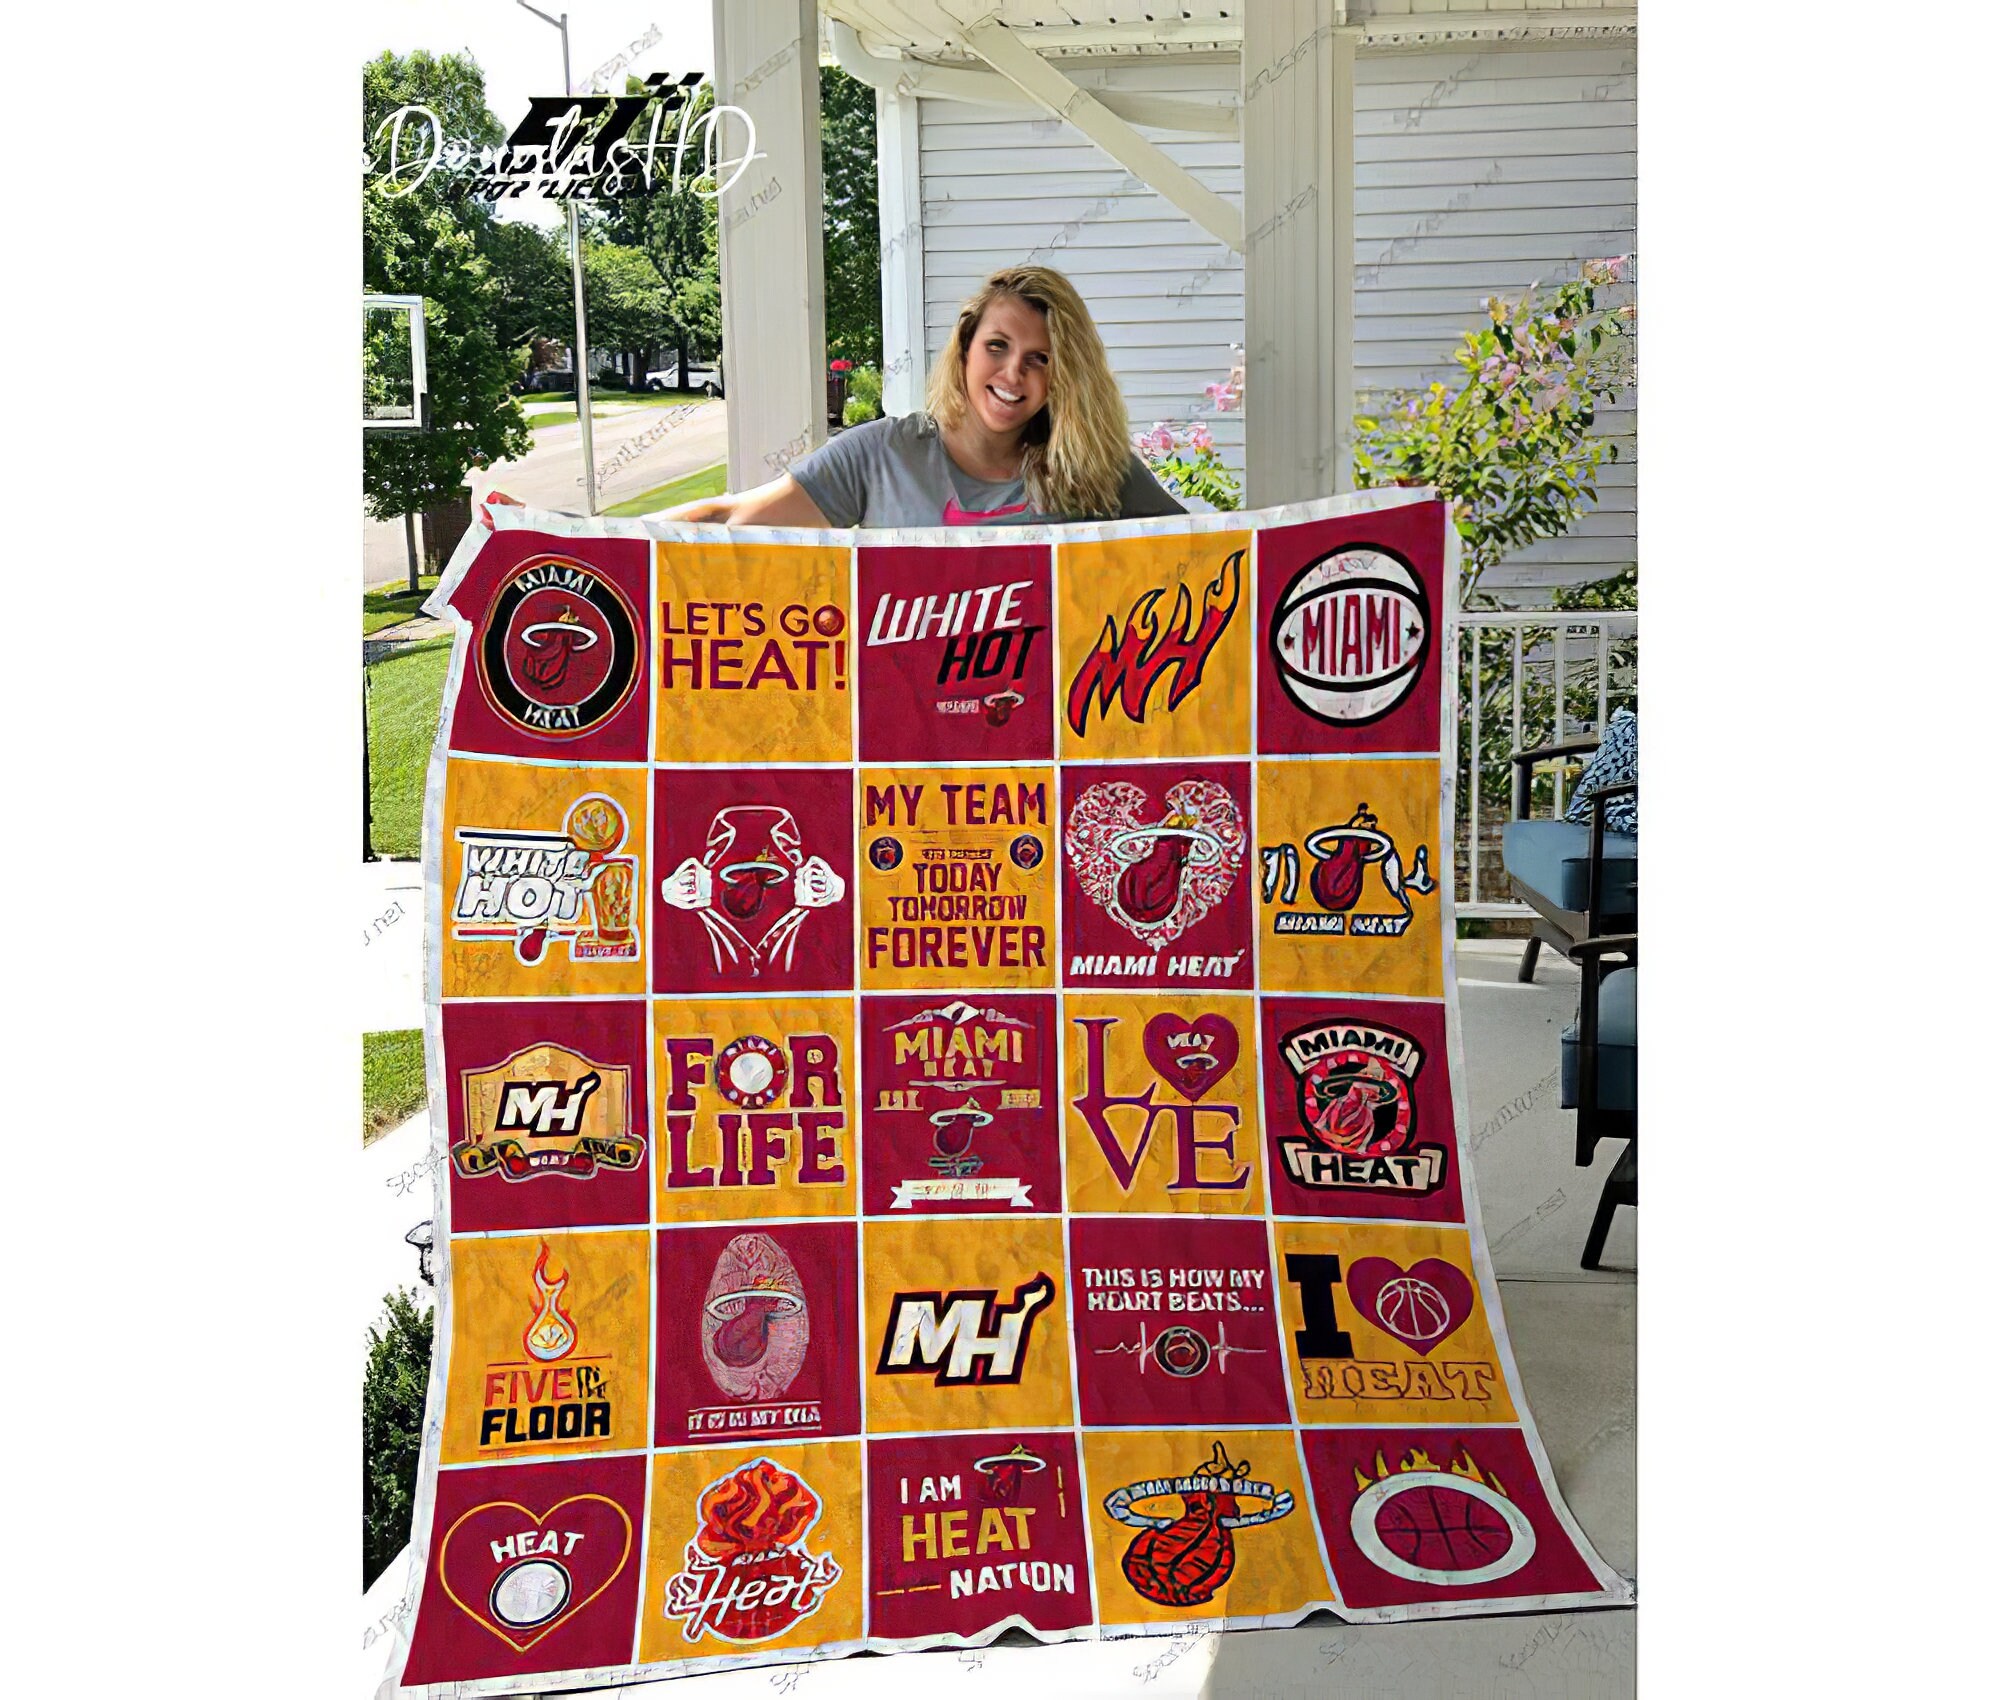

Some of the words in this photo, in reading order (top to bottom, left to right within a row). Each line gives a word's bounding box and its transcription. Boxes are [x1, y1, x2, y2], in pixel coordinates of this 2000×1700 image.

[662, 601, 767, 638] LET'S
[779, 603, 846, 638] GO
[866, 580, 1034, 647] WHITE
[1302, 593, 1401, 676] MIAMI
[661, 638, 847, 691] HEAT!
[936, 625, 1048, 685] HOT
[866, 784, 923, 827] MY
[940, 782, 1047, 826] TEAM
[457, 874, 586, 921] HOT
[912, 862, 1003, 893] TODAY
[887, 895, 1028, 922] TOMORROW
[867, 926, 1047, 969] FOREVER
[1069, 954, 1158, 976] MIAMI
[1166, 947, 1246, 978] HEAT
[894, 1026, 1024, 1065] MIAMI
[495, 1071, 601, 1137] MH
[666, 1111, 845, 1188] LIFE
[1311, 1154, 1421, 1187] HEAT
[1082, 1268, 1136, 1288] THIS
[1169, 1269, 1224, 1288] HOW
[1285, 1253, 1355, 1359] I
[876, 1271, 1056, 1387] MH
[485, 1368, 573, 1407] FIVE
[480, 1402, 611, 1446] FLOOR
[900, 1476, 909, 1504] I
[919, 1474, 962, 1503] AM
[489, 1530, 585, 1564] HEAT
[900, 1505, 1037, 1563] HEAT
[688, 1560, 820, 1635] Heat
[949, 1560, 1076, 1600] NATION
